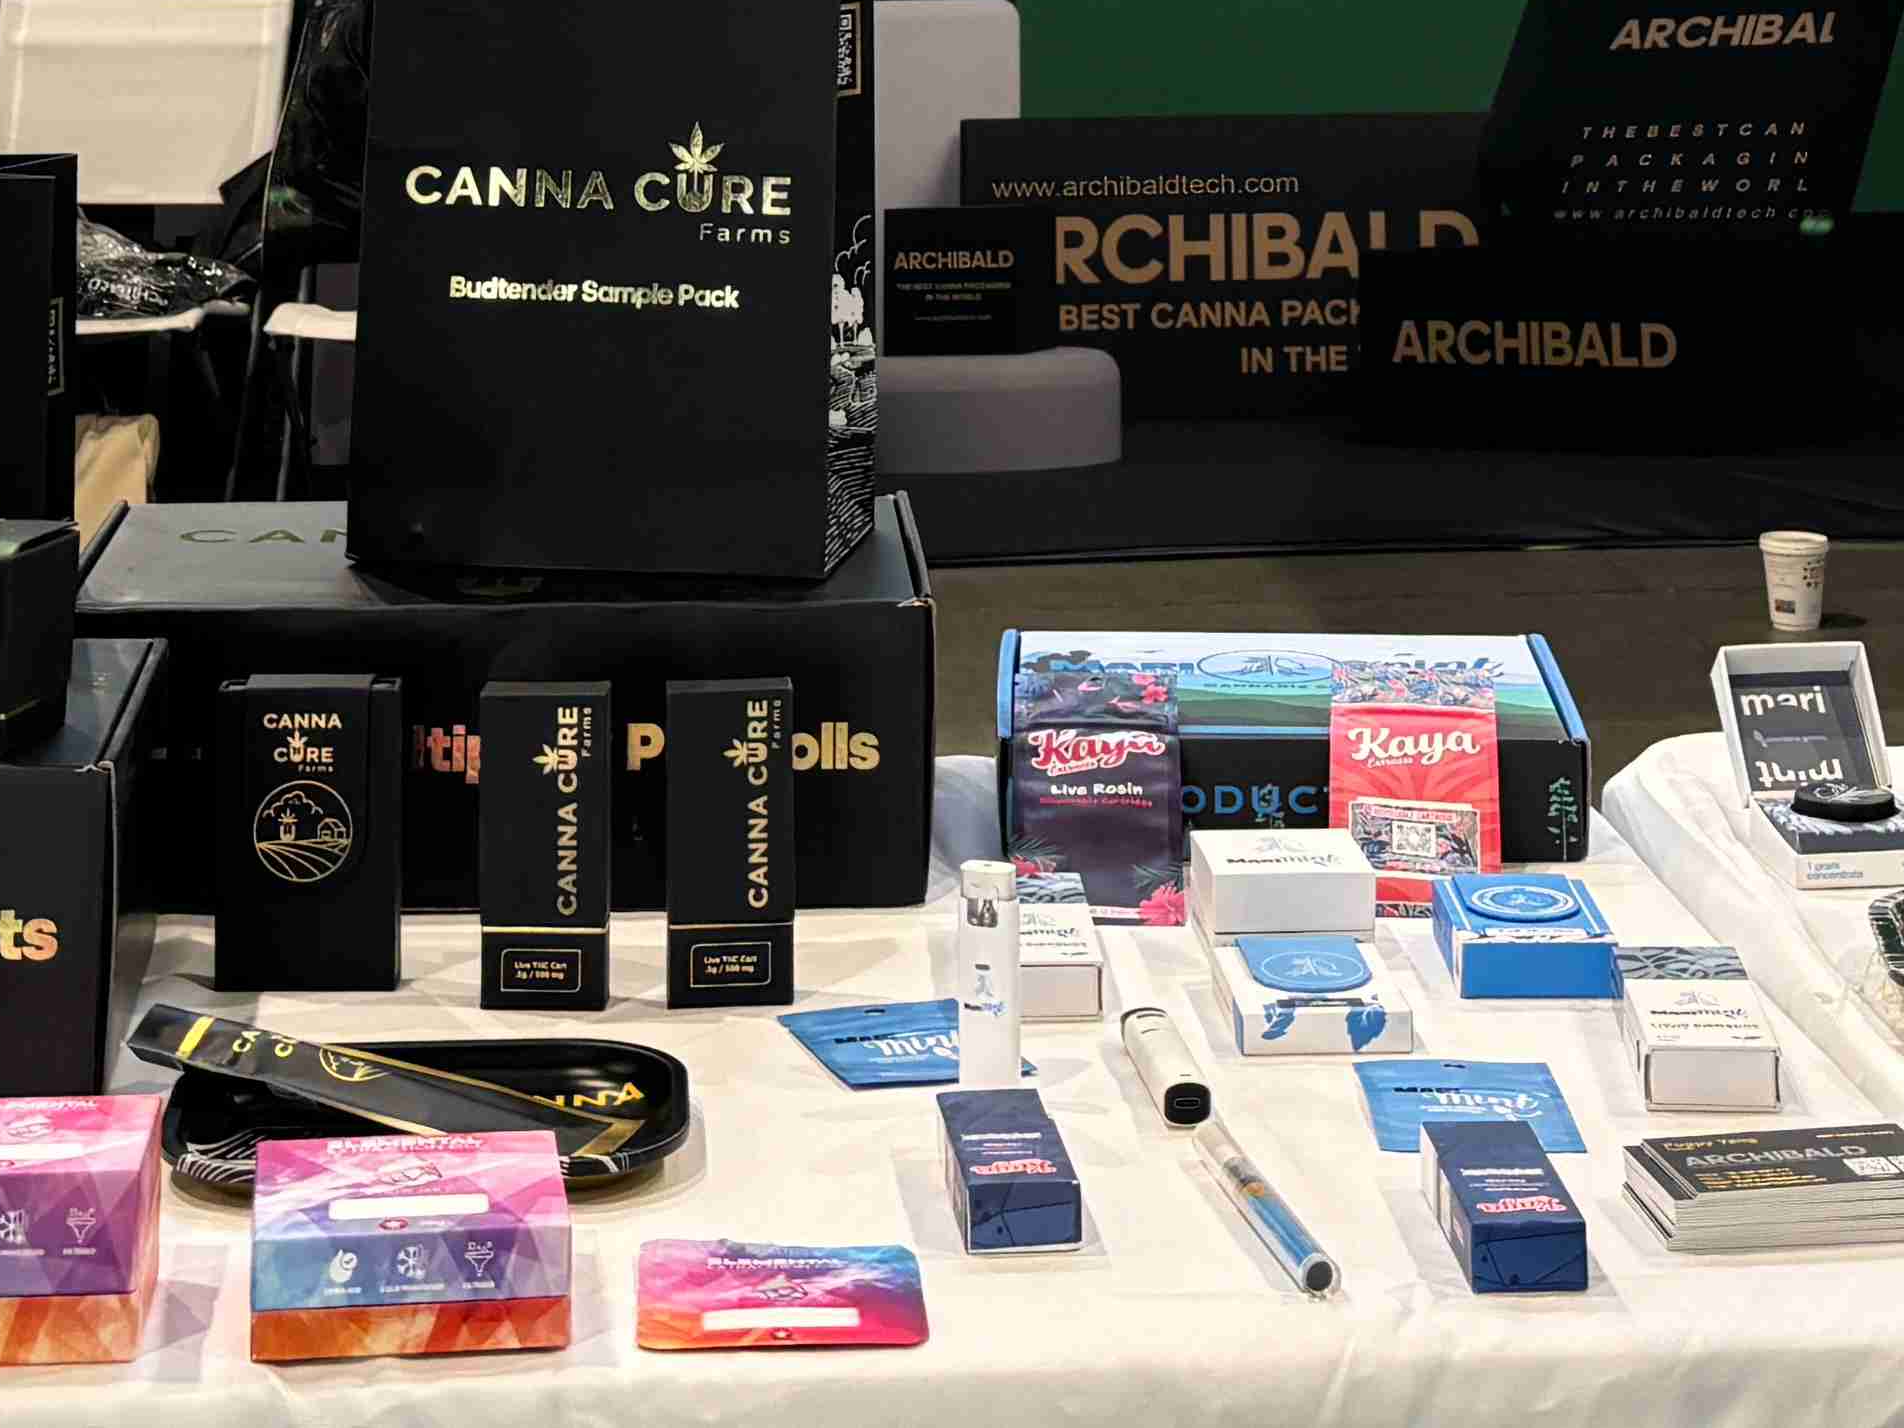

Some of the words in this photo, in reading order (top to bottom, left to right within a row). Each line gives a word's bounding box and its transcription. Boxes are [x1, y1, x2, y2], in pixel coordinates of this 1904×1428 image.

[404, 165, 615, 210] CANNA
[633, 172, 793, 217] CURE
[992, 173, 1300, 200] www.archibaldtech.com
[698, 221, 792, 246] Farms
[894, 249, 1015, 271] ARCHIBALD
[448, 273, 579, 304] Budtender
[580, 279, 675, 309] Sample
[677, 282, 740, 310] Pack
[1058, 302, 1142, 332] BEST
[1151, 300, 1272, 331] CANNA
[1240, 346, 1274, 375] IN
[1282, 344, 1348, 373] THE
[1391, 319, 1678, 369] ARCHIBALD
[1739, 684, 1827, 716] mari
[262, 712, 343, 730] CANNA
[581, 706, 593, 759] Farms
[771, 698, 783, 750] Farms
[273, 744, 335, 764] CURE
[556, 705, 580, 794] CURE
[747, 698, 770, 787] CURE
[1027, 728, 1167, 771] Kaya
[1346, 726, 1481, 767] Kaya
[1049, 783, 1088, 795] Live
[1092, 781, 1144, 795] Rosin
[1181, 784, 1331, 816] ODUC
[556, 802, 579, 917] CANNA
[747, 794, 770, 910] CANNA
[1685, 1145, 1868, 1168] ARCHIBALD
